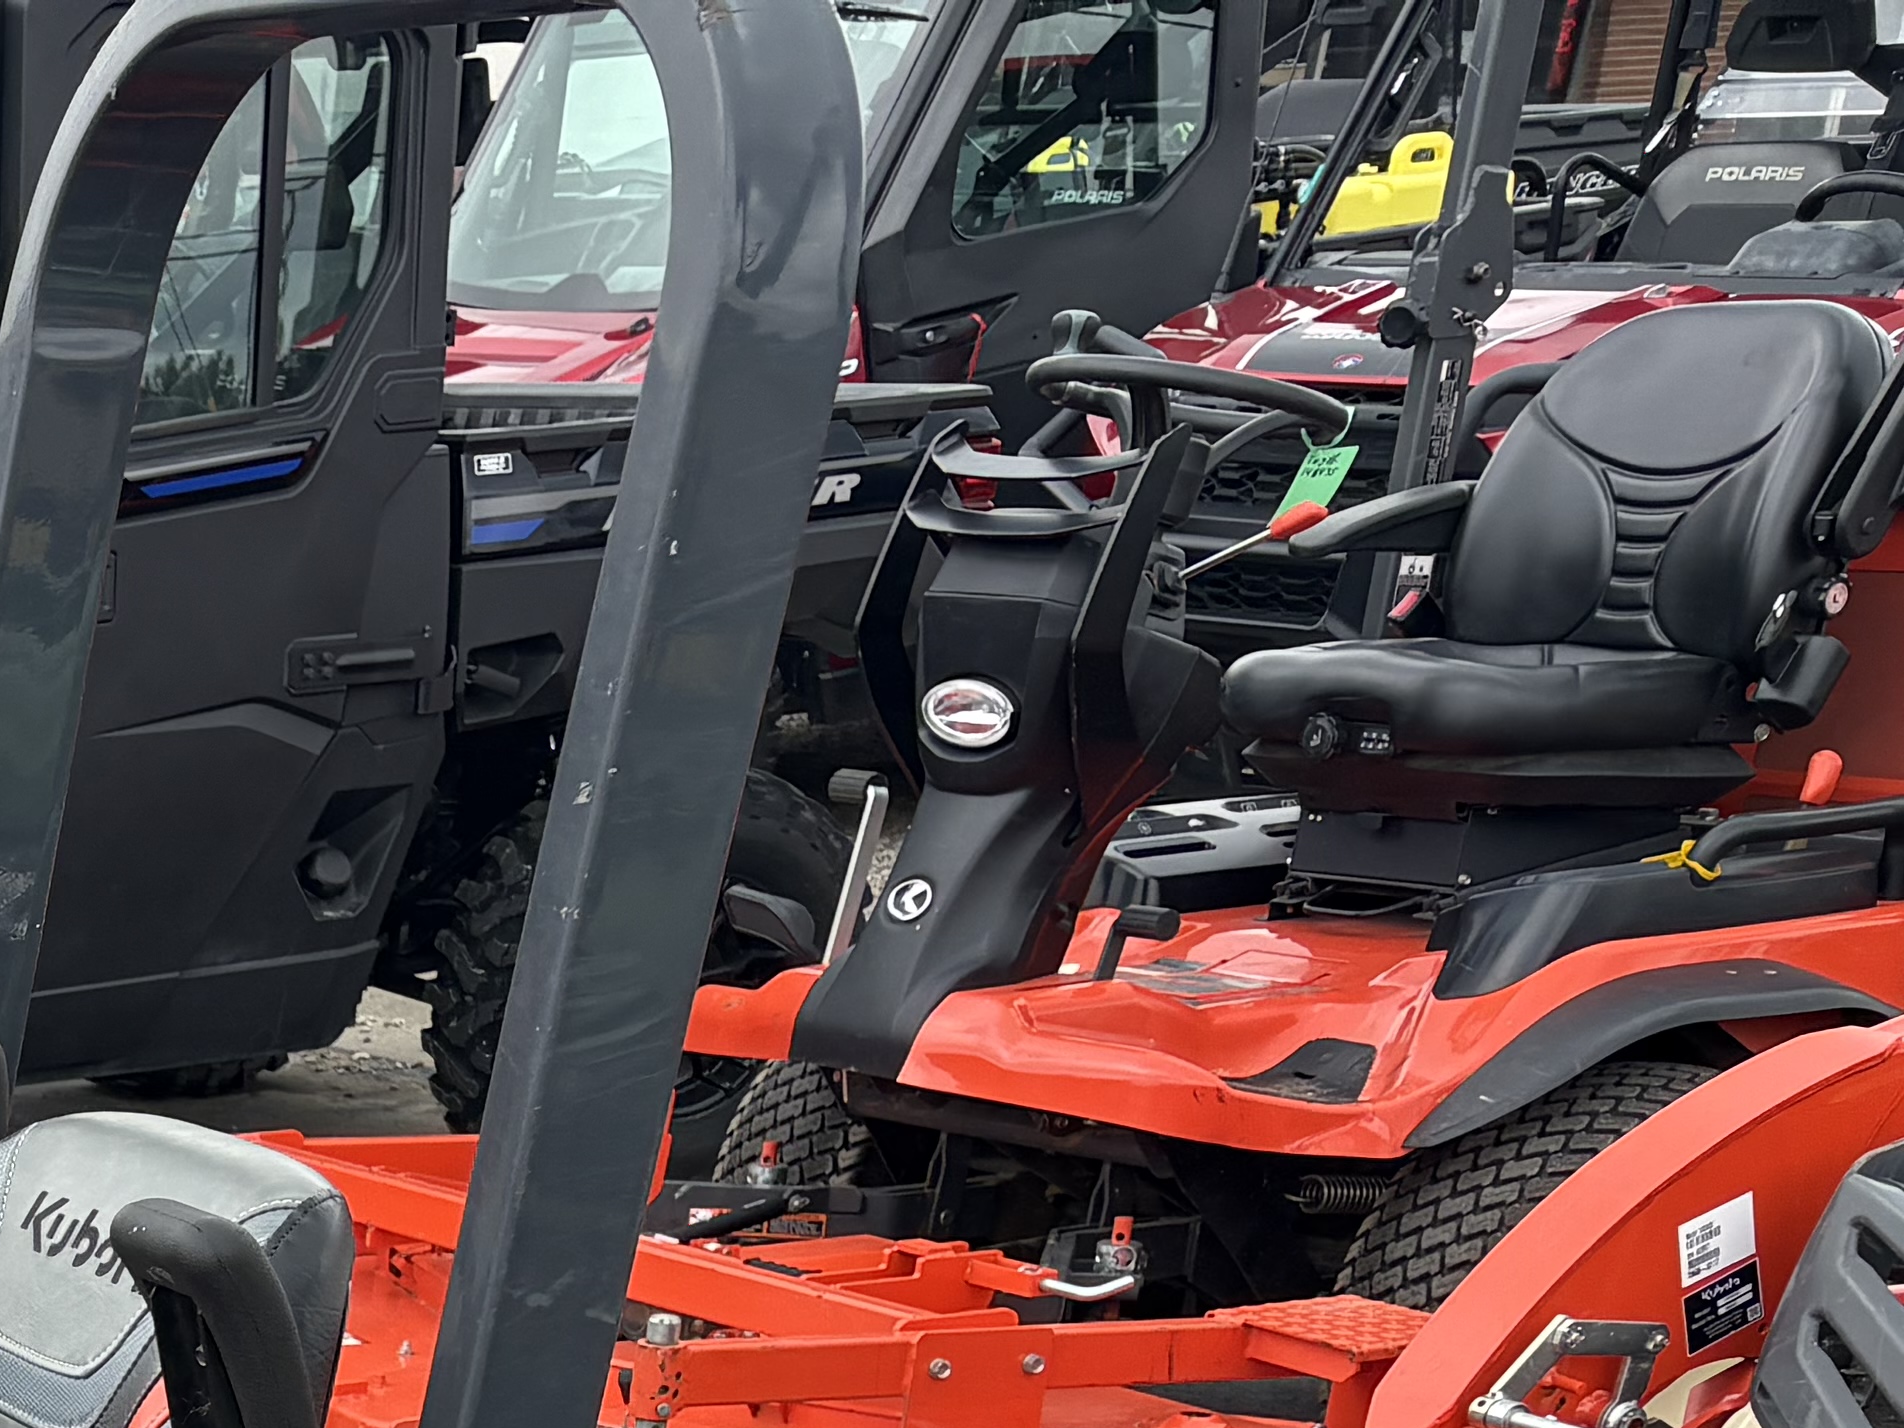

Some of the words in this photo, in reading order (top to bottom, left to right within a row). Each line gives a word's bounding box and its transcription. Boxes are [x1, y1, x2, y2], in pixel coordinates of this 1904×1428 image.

[1705, 166, 1806, 183] POLARIS
[1051, 190, 1125, 205] POLARIS
[20, 1190, 138, 1292] Kubo
[1702, 1277, 1741, 1301] Kubota
